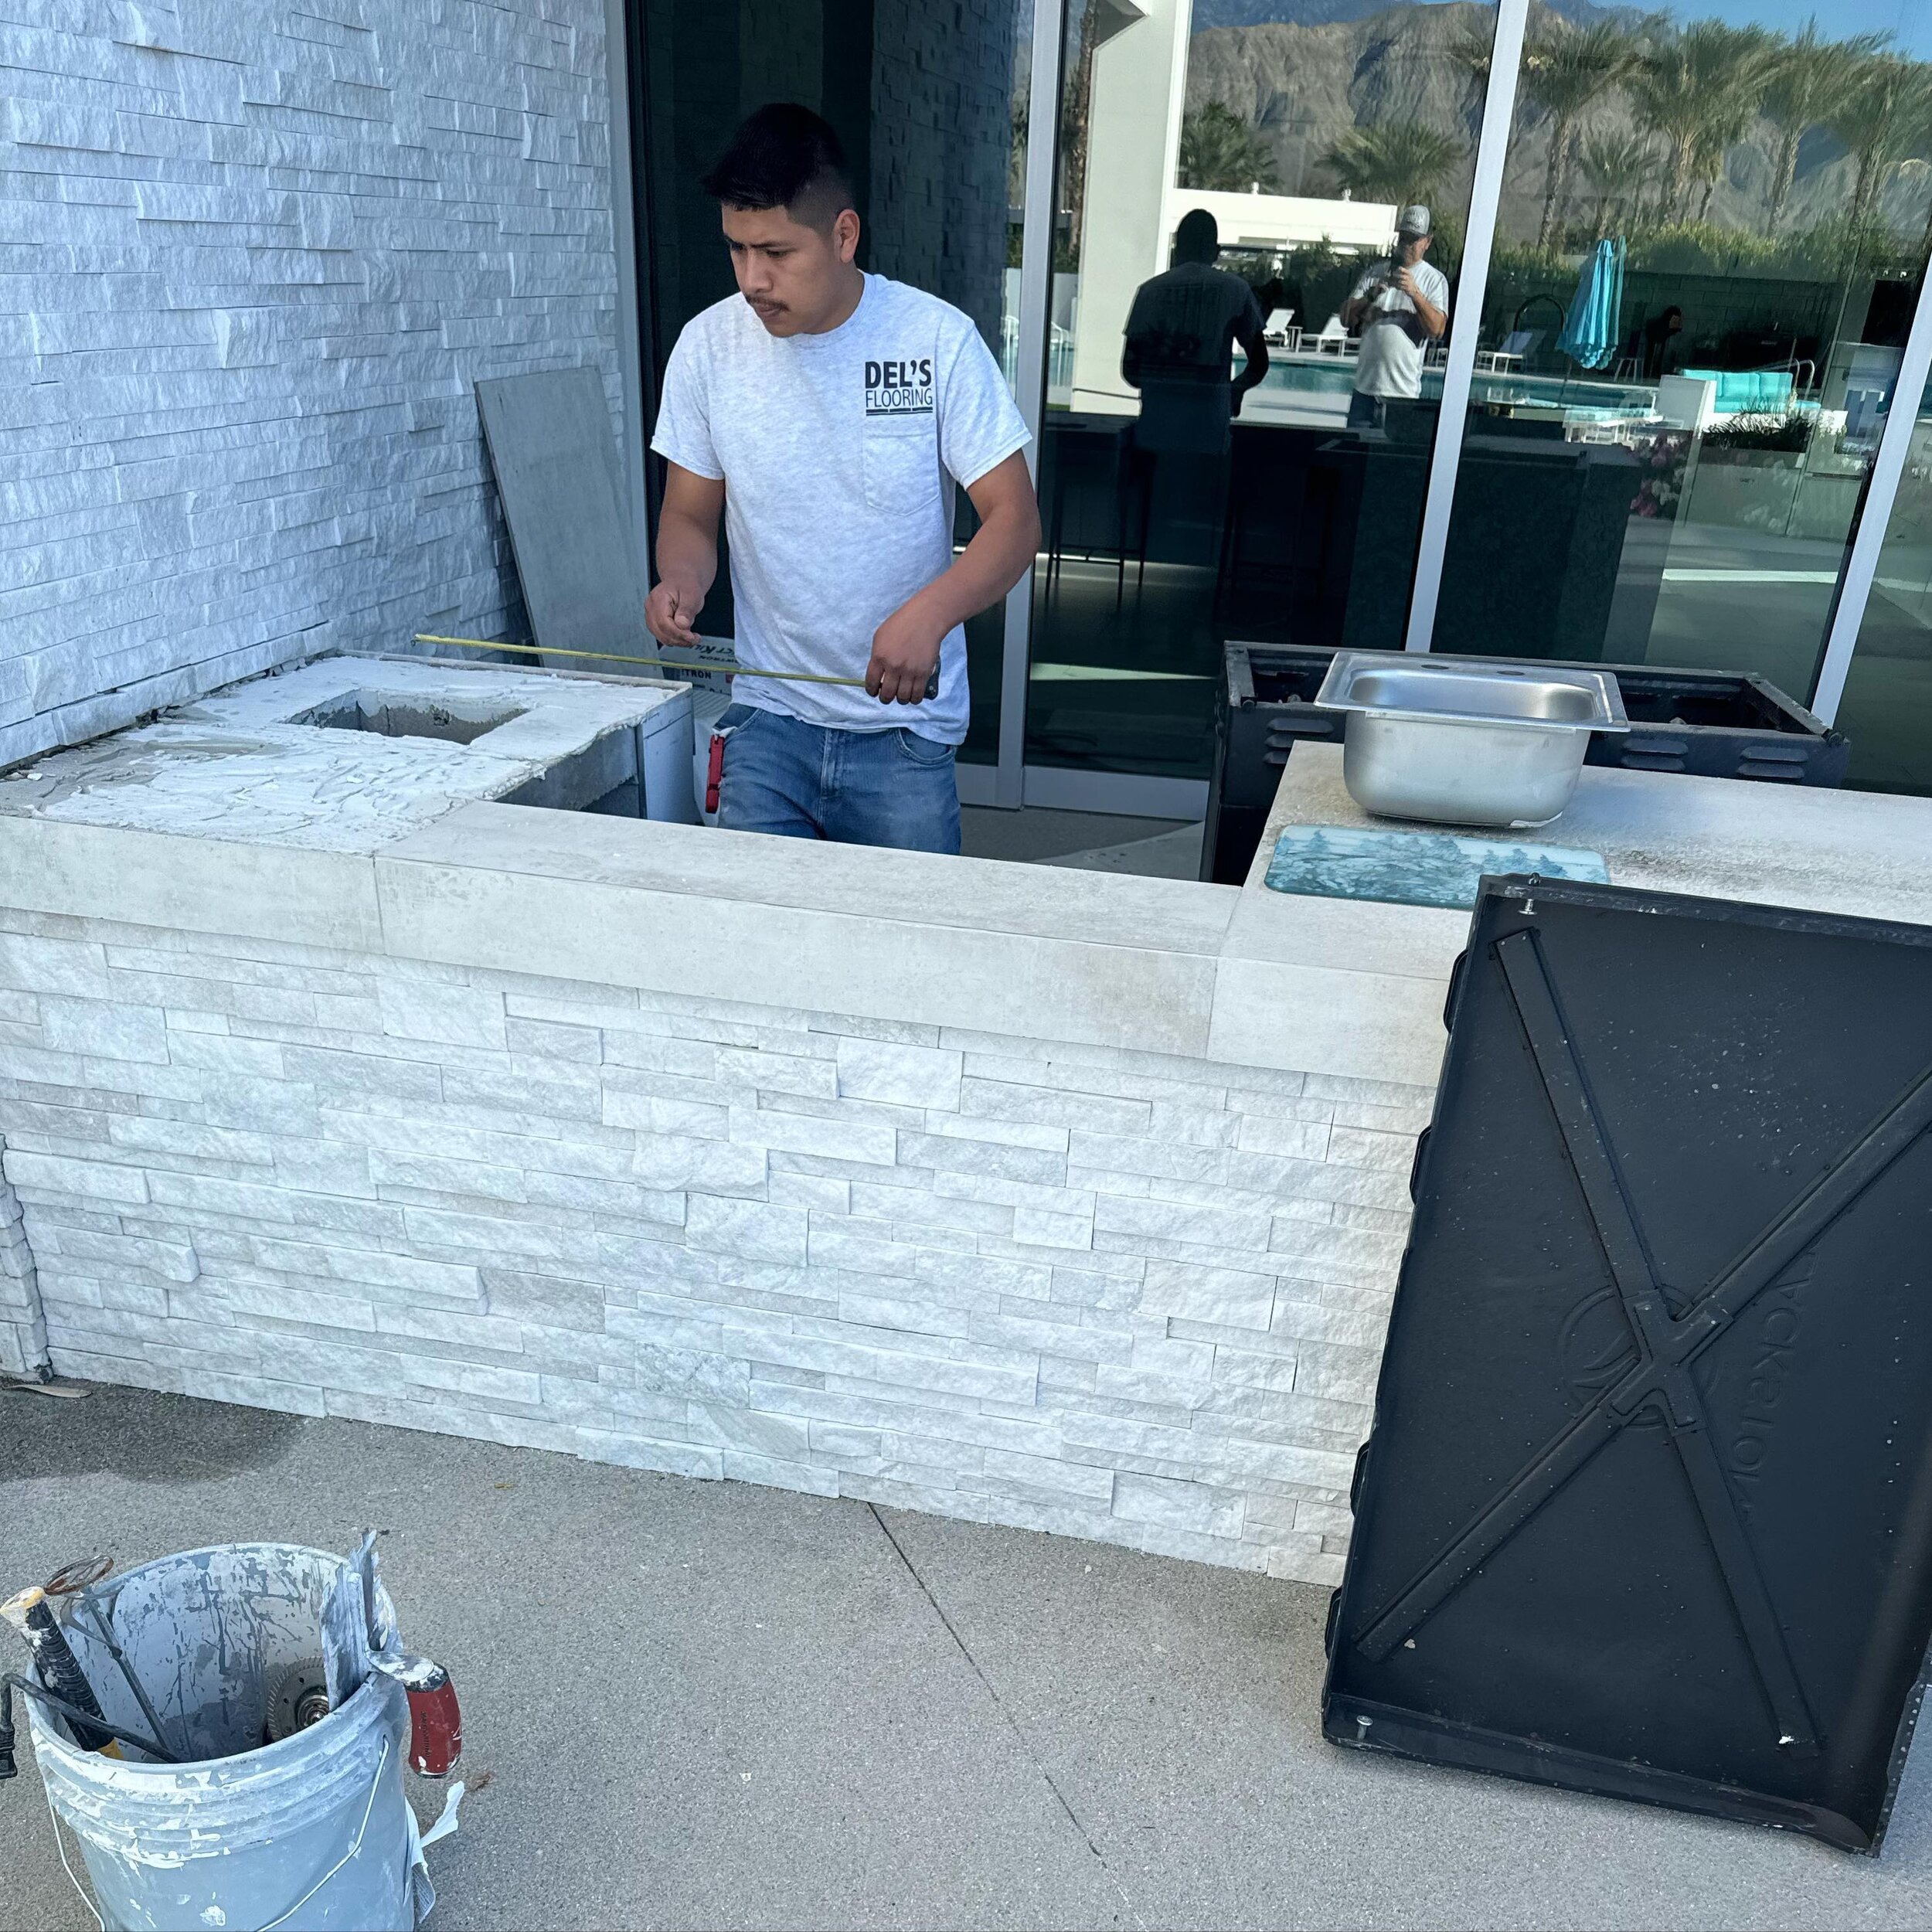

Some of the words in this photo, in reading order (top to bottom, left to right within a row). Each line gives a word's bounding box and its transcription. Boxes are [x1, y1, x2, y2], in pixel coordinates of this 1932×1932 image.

[865, 359, 932, 389] DEL'S
[866, 388, 933, 408] FLOORING
[681, 668, 711, 679] TRON
